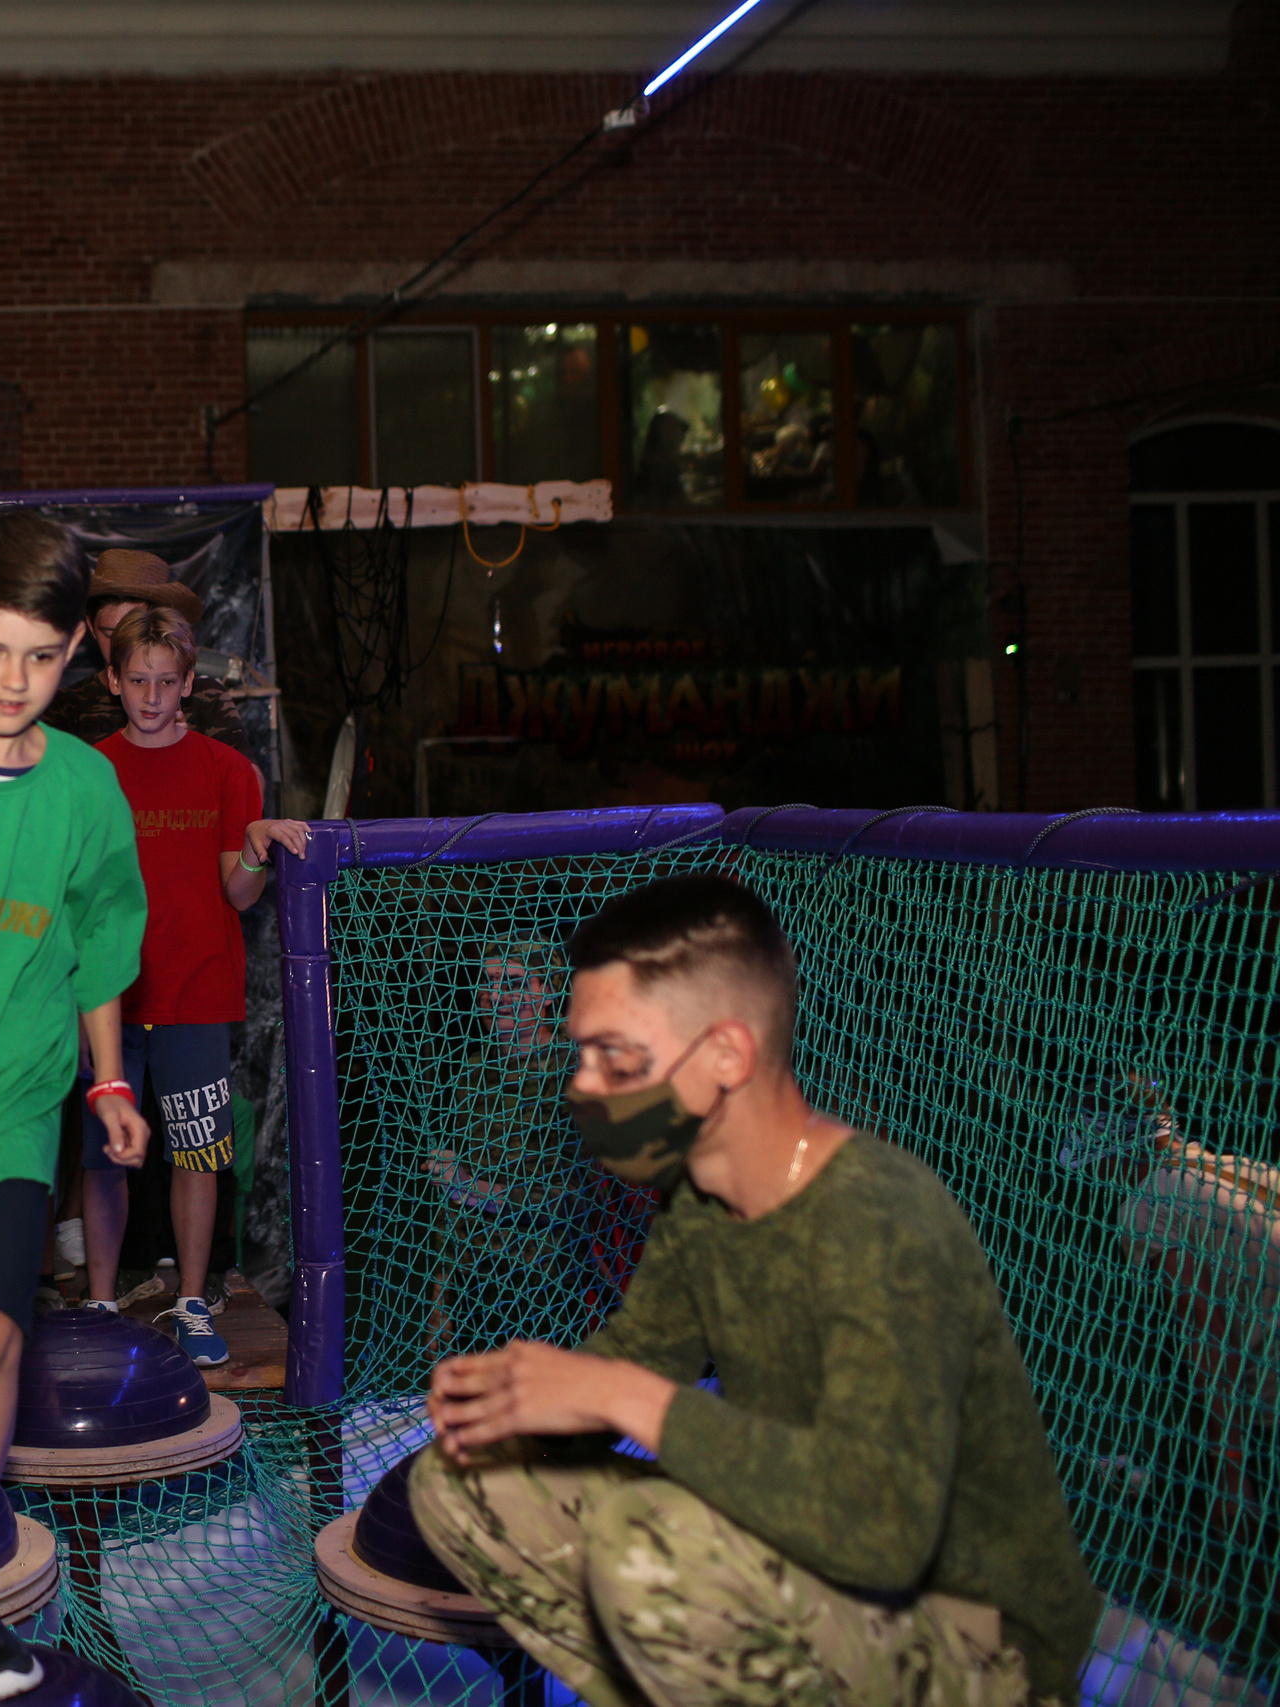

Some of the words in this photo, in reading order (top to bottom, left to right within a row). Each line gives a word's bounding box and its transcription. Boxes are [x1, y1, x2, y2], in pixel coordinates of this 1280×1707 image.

[447, 664, 901, 757] ДЖУМАНДЖИ
[676, 741, 737, 761] ШОУ
[160, 1077, 231, 1121] NEVER
[167, 1115, 216, 1149] STOP
